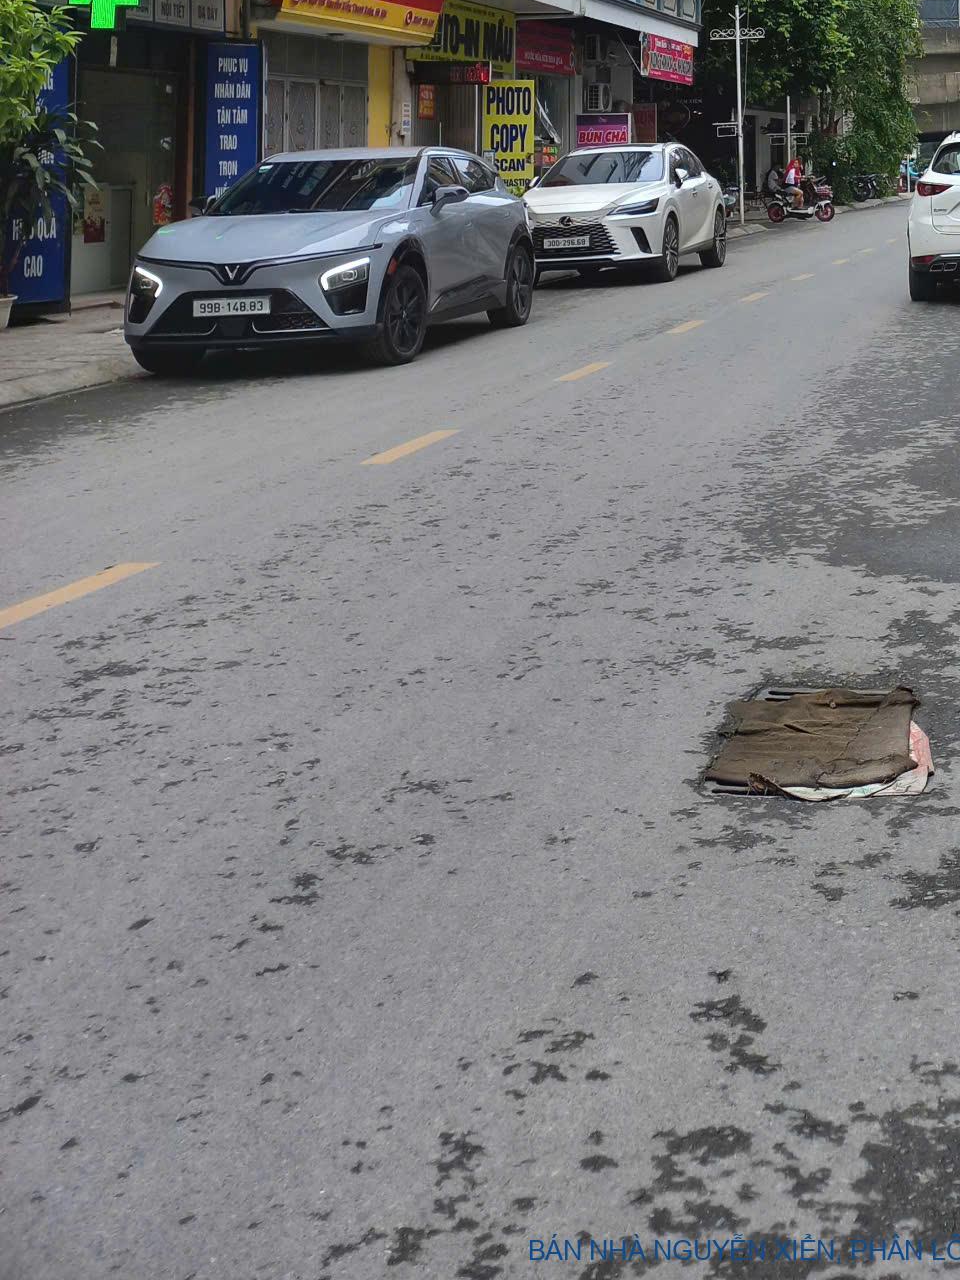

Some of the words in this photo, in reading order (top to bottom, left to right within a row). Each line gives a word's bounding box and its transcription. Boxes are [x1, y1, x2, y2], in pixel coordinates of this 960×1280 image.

[218, 58, 238, 76] PHỤC
[239, 58, 248, 76] VỤ
[214, 80, 235, 99] NHÂN
[236, 80, 251, 99] DÂN
[486, 86, 532, 116] PHOTO
[217, 106, 231, 128] TẬN
[232, 106, 248, 125] TÂM
[219, 134, 238, 151] TRAO
[490, 123, 528, 153] COPY
[578, 127, 604, 145] BÚN
[604, 125, 628, 144] CHẢ
[219, 160, 238, 180] TRỌN
[494, 158, 525, 172] SCAN
[23, 255, 43, 278] CAO
[199, 300, 264, 314] 99B-148.83
